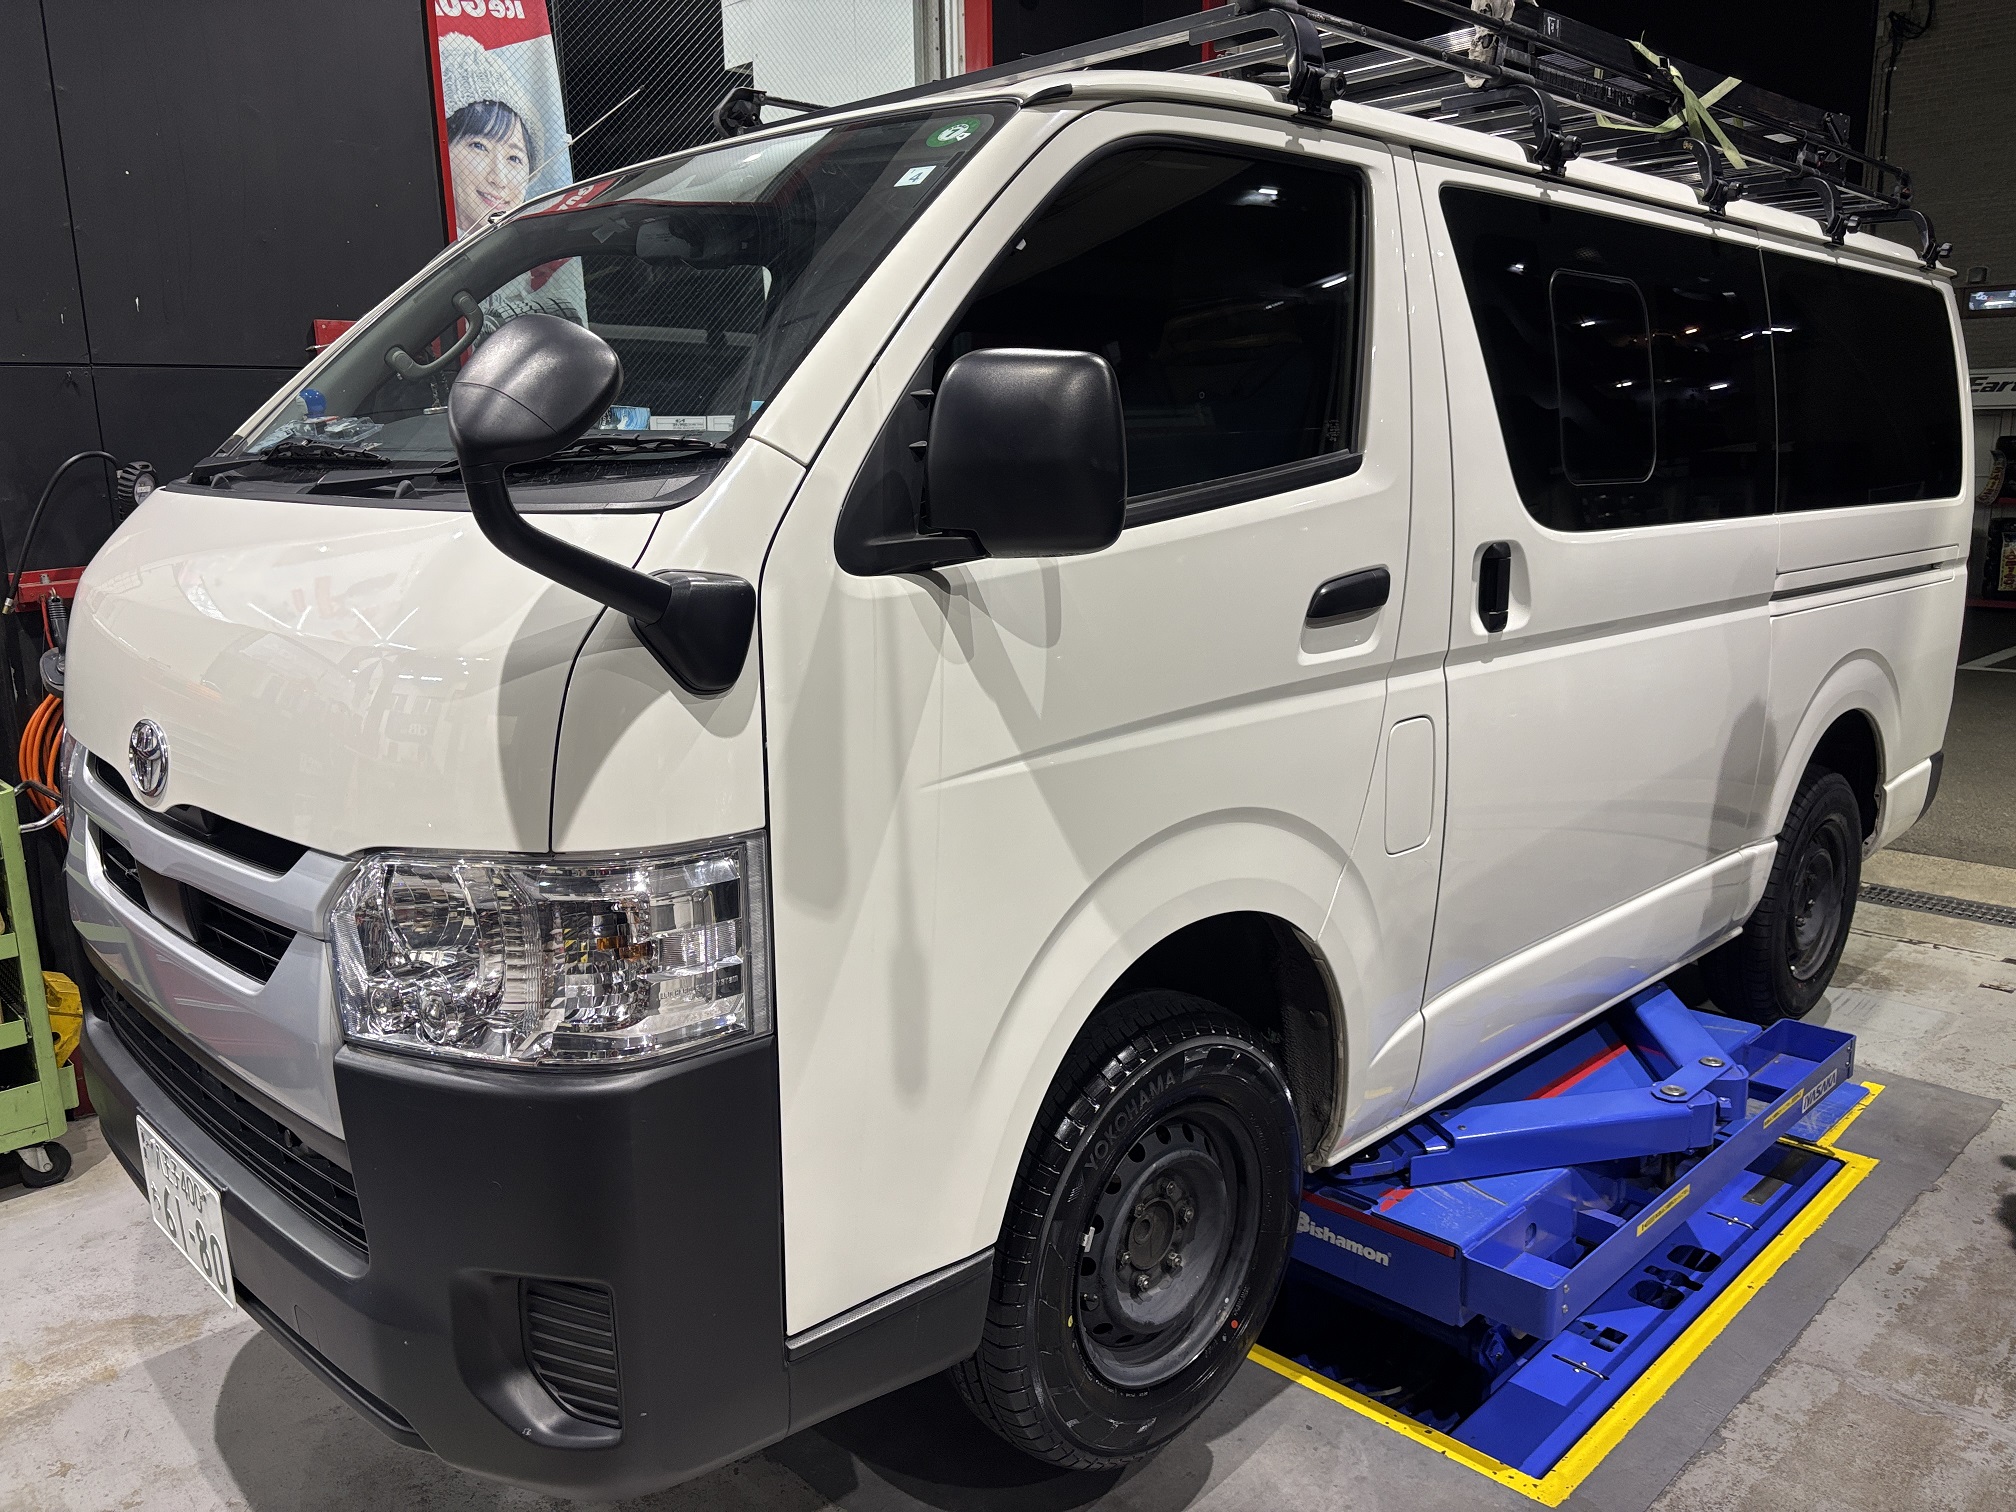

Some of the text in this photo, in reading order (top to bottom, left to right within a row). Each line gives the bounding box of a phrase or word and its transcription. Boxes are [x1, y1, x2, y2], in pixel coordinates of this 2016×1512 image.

[909, 171, 923, 182] 4
[1084, 1069, 1175, 1171] YOKOHAMA
[181, 1170, 203, 1213] 400
[164, 1185, 228, 1295] 61-80
[1296, 1210, 1389, 1266] Bishamon
